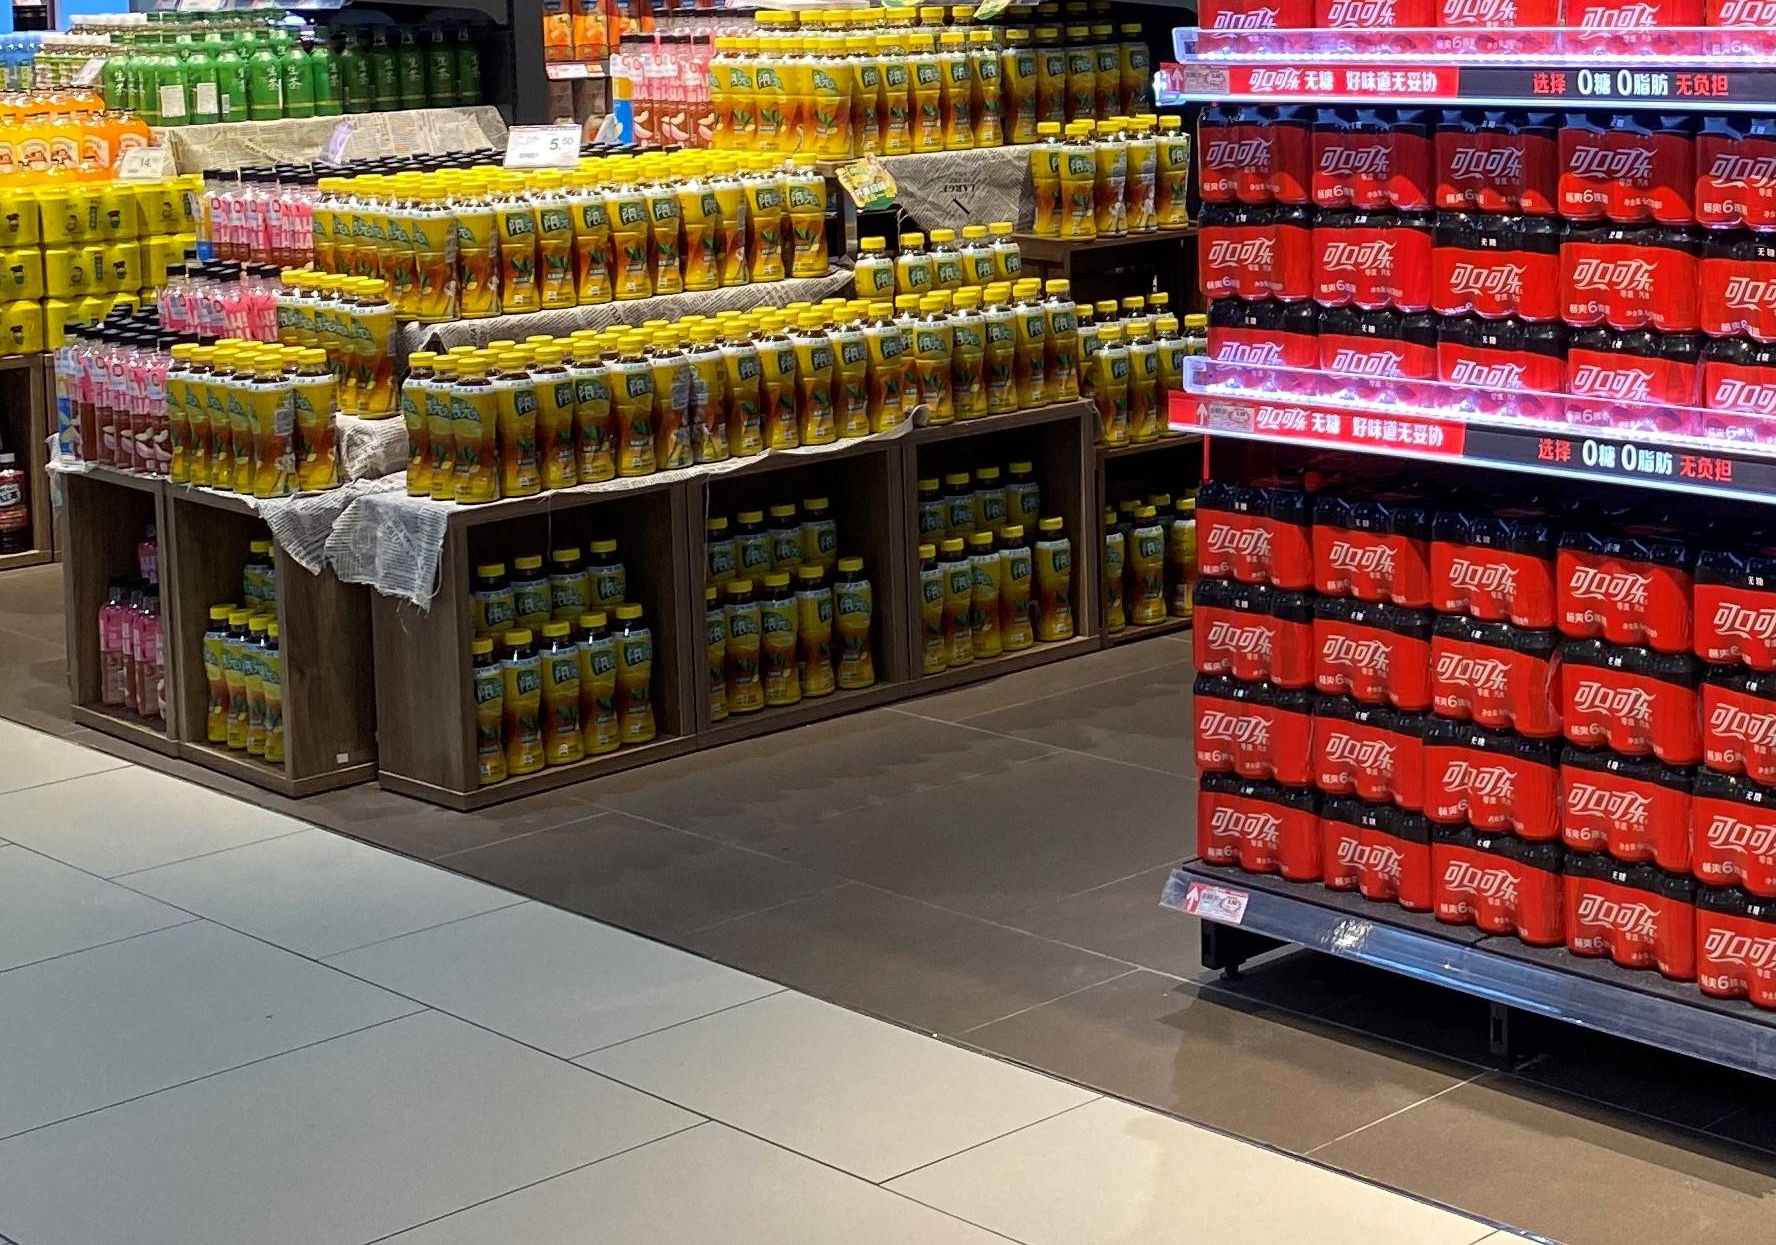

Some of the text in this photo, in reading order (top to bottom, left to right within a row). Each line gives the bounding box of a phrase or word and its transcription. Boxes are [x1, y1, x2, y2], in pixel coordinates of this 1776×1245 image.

[1248, 67, 1437, 93] 可口可乐 无糖 好味道无妥协
[1533, 69, 1729, 96] 选择 0糖 0脂肪 无负担
[1320, 145, 1390, 177] 可口可乐
[1571, 143, 1653, 180] 可口可乐
[1209, 237, 1276, 269] 可口可乐
[1450, 261, 1524, 293] 可口可乐
[1575, 362, 1655, 400] 可口可乐
[1255, 405, 1443, 449] 可口可乐 无糖 好味道无妥协
[1538, 438, 1732, 482] 选择 0糖 0脂肪 无负担
[1449, 561, 1520, 594] 可口可乐
[1569, 569, 1649, 604] 可口可乐
[1209, 622, 1275, 653] 可口可乐
[1437, 650, 1509, 688] 可口可乐
[1326, 737, 1395, 769] 可口可乐
[1443, 761, 1516, 795] 可口可乐
[1338, 836, 1405, 873] 可口可乐
[1577, 893, 1657, 928] 可口可乐
